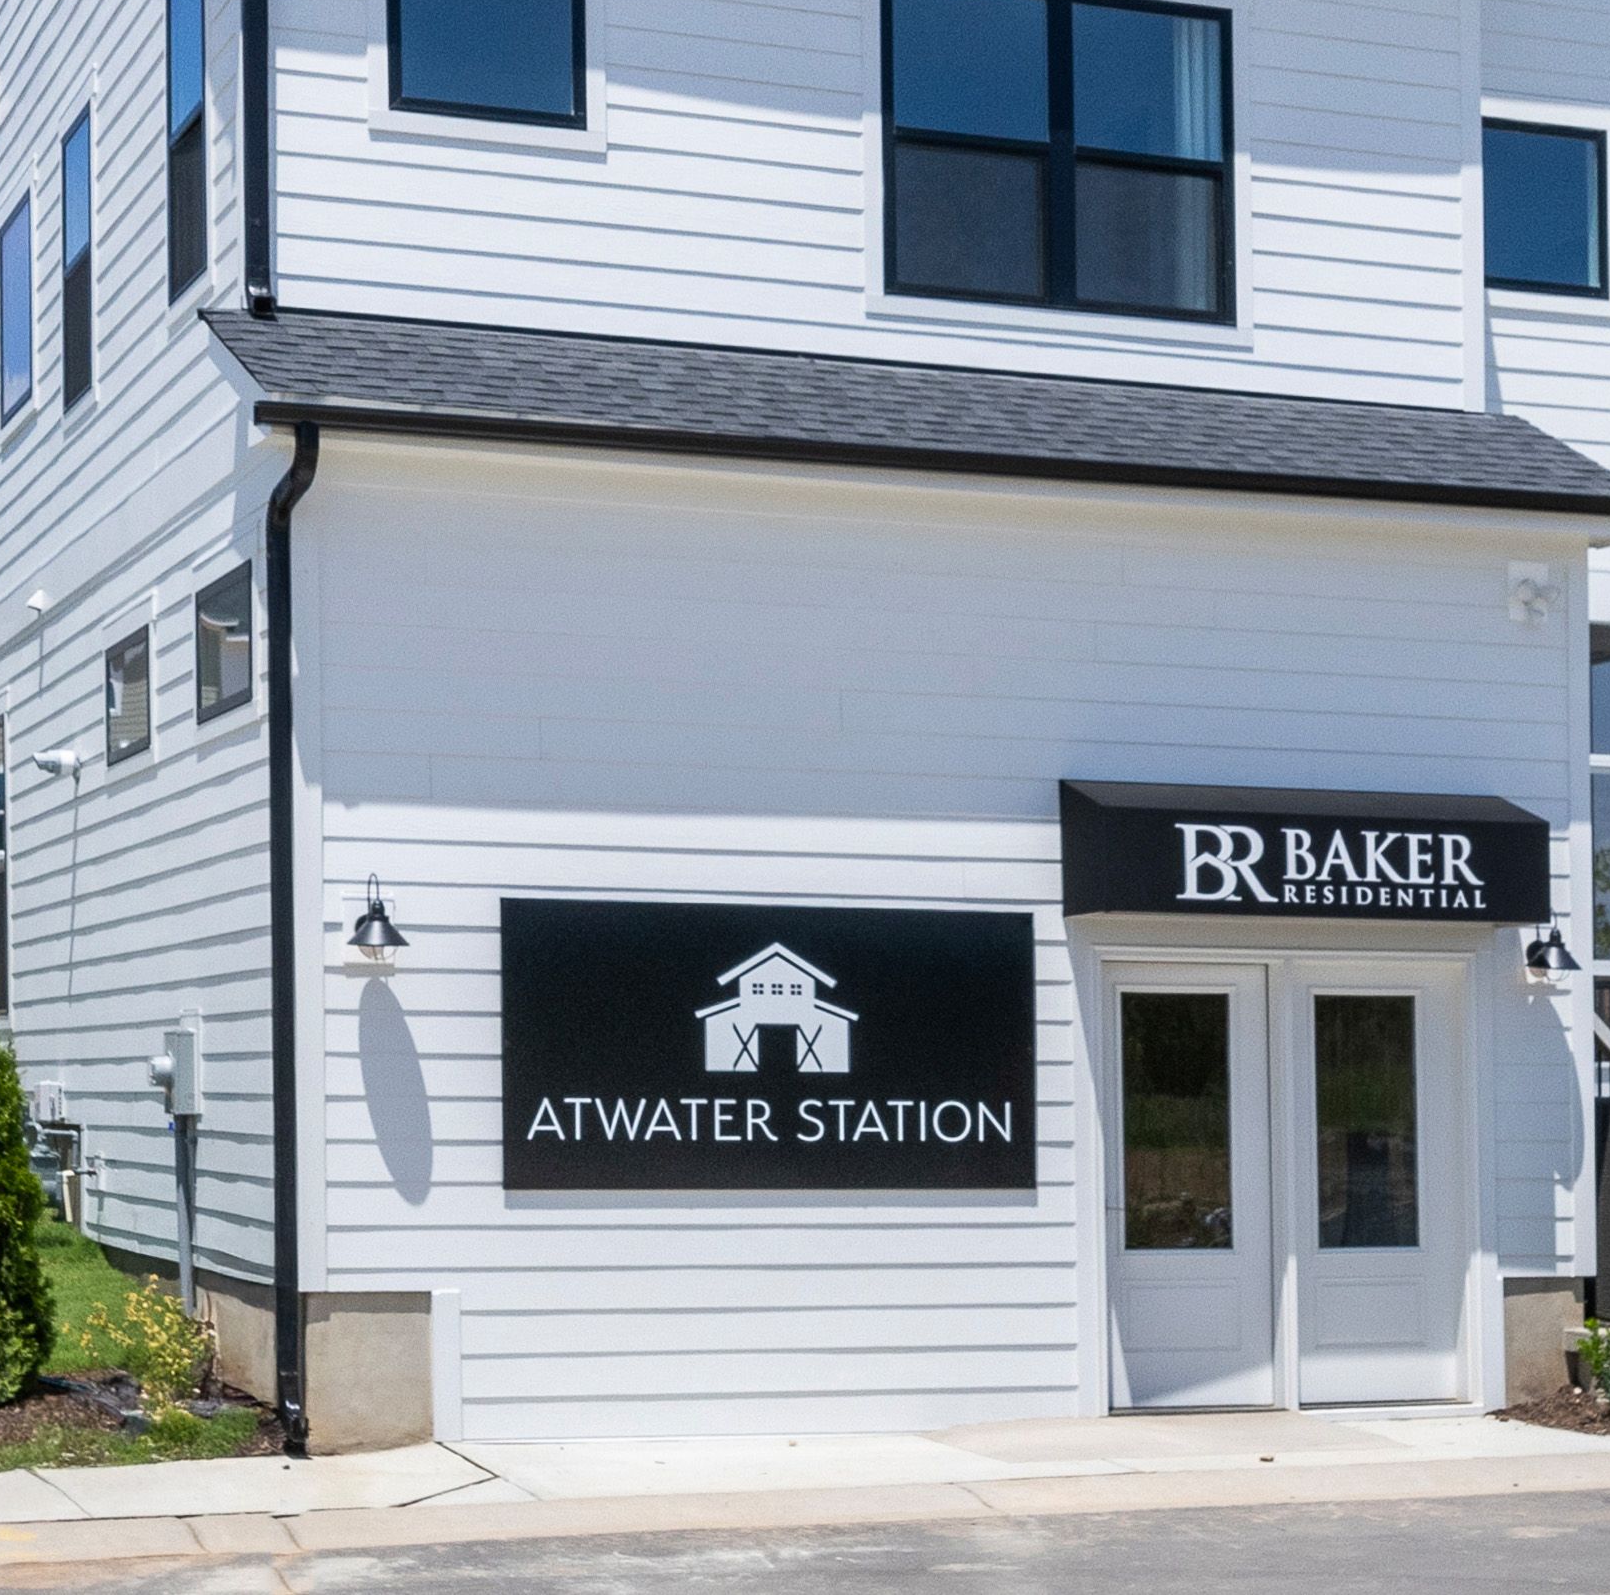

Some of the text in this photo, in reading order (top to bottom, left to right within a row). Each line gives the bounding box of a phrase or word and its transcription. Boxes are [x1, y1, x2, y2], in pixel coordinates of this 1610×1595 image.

[1174, 822, 1279, 903] BR
[1280, 828, 1485, 886] BAKER
[1283, 884, 1487, 909] RESIDENTIAL
[525, 1096, 1012, 1144] ATWATER STATION
